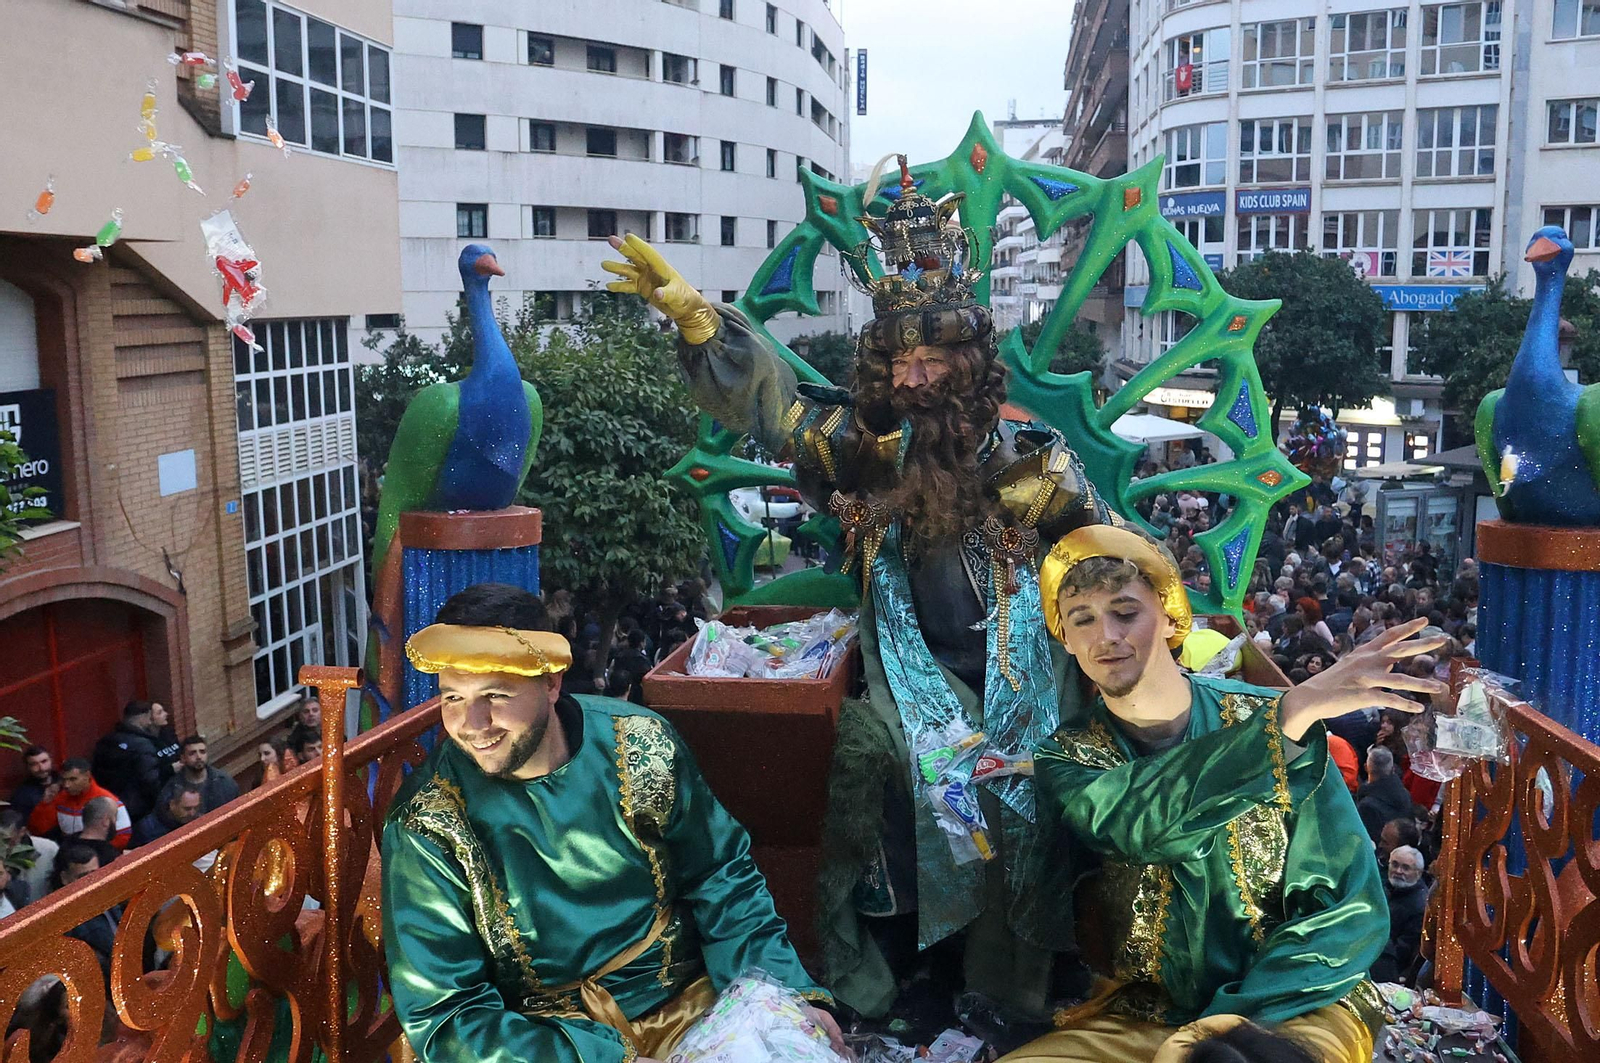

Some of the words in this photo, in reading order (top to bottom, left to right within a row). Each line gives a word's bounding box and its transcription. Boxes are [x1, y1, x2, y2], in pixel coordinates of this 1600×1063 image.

[1239, 195, 1258, 209] KIDS
[1260, 194, 1281, 208] CLUB
[1282, 194, 1307, 208] SPAIN
[1187, 203, 1220, 215] HUELVA
